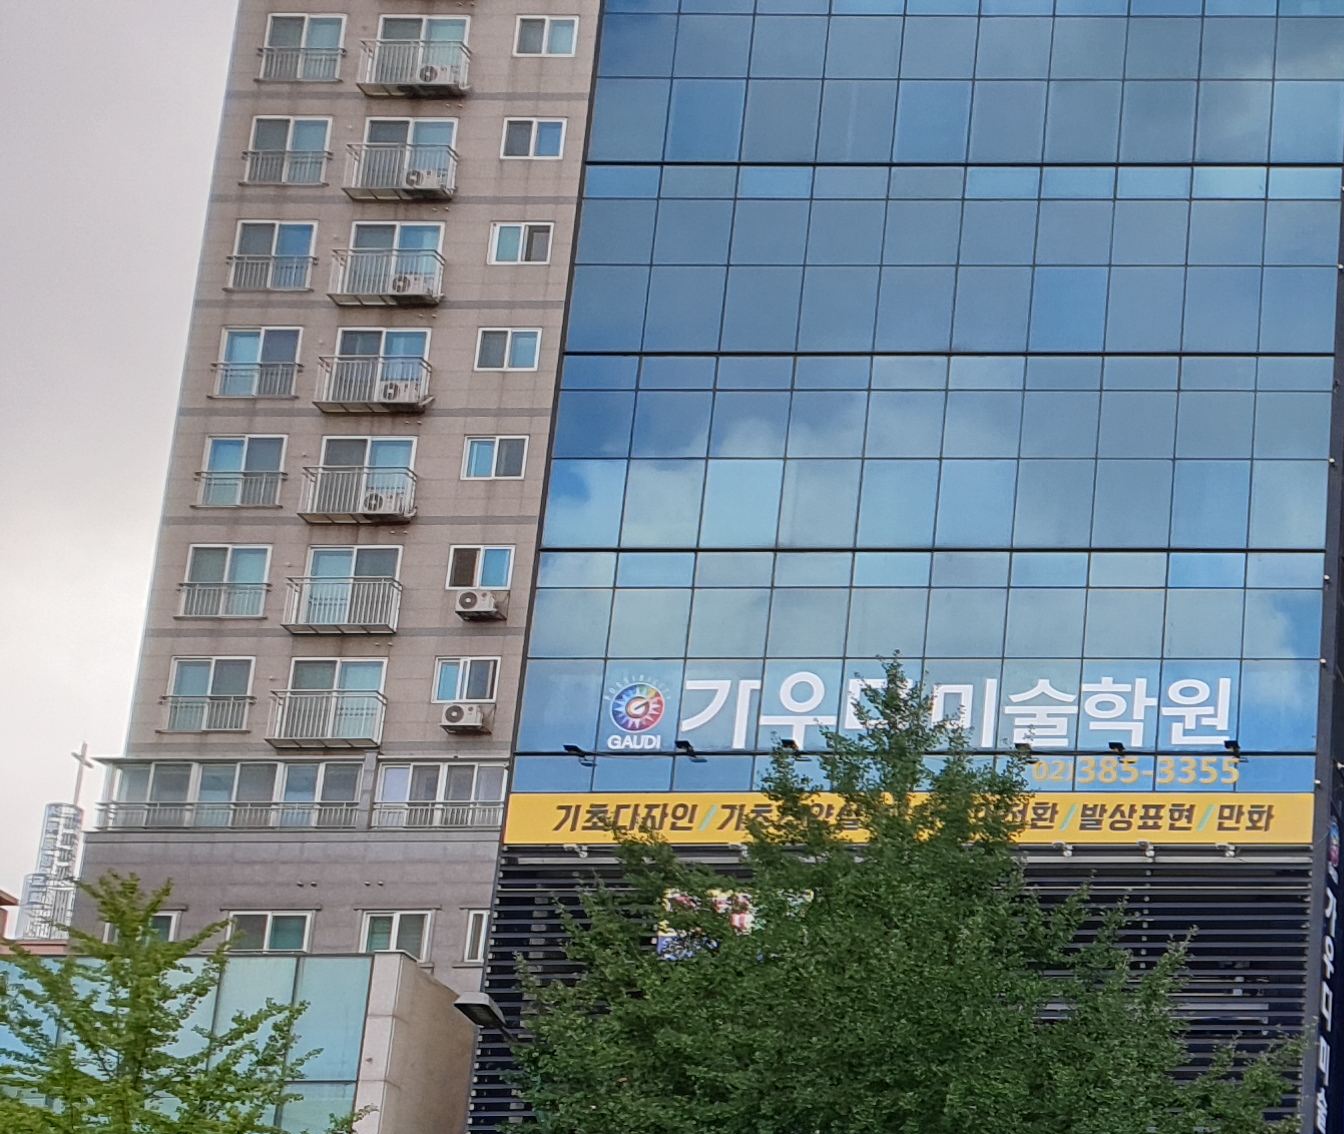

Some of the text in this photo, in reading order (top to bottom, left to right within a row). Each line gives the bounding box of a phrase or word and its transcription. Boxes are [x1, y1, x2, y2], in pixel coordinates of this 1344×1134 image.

[607, 734, 661, 750] GAUDI
[1079, 804, 1196, 832] 발상표현
[1216, 806, 1275, 832] 만화
